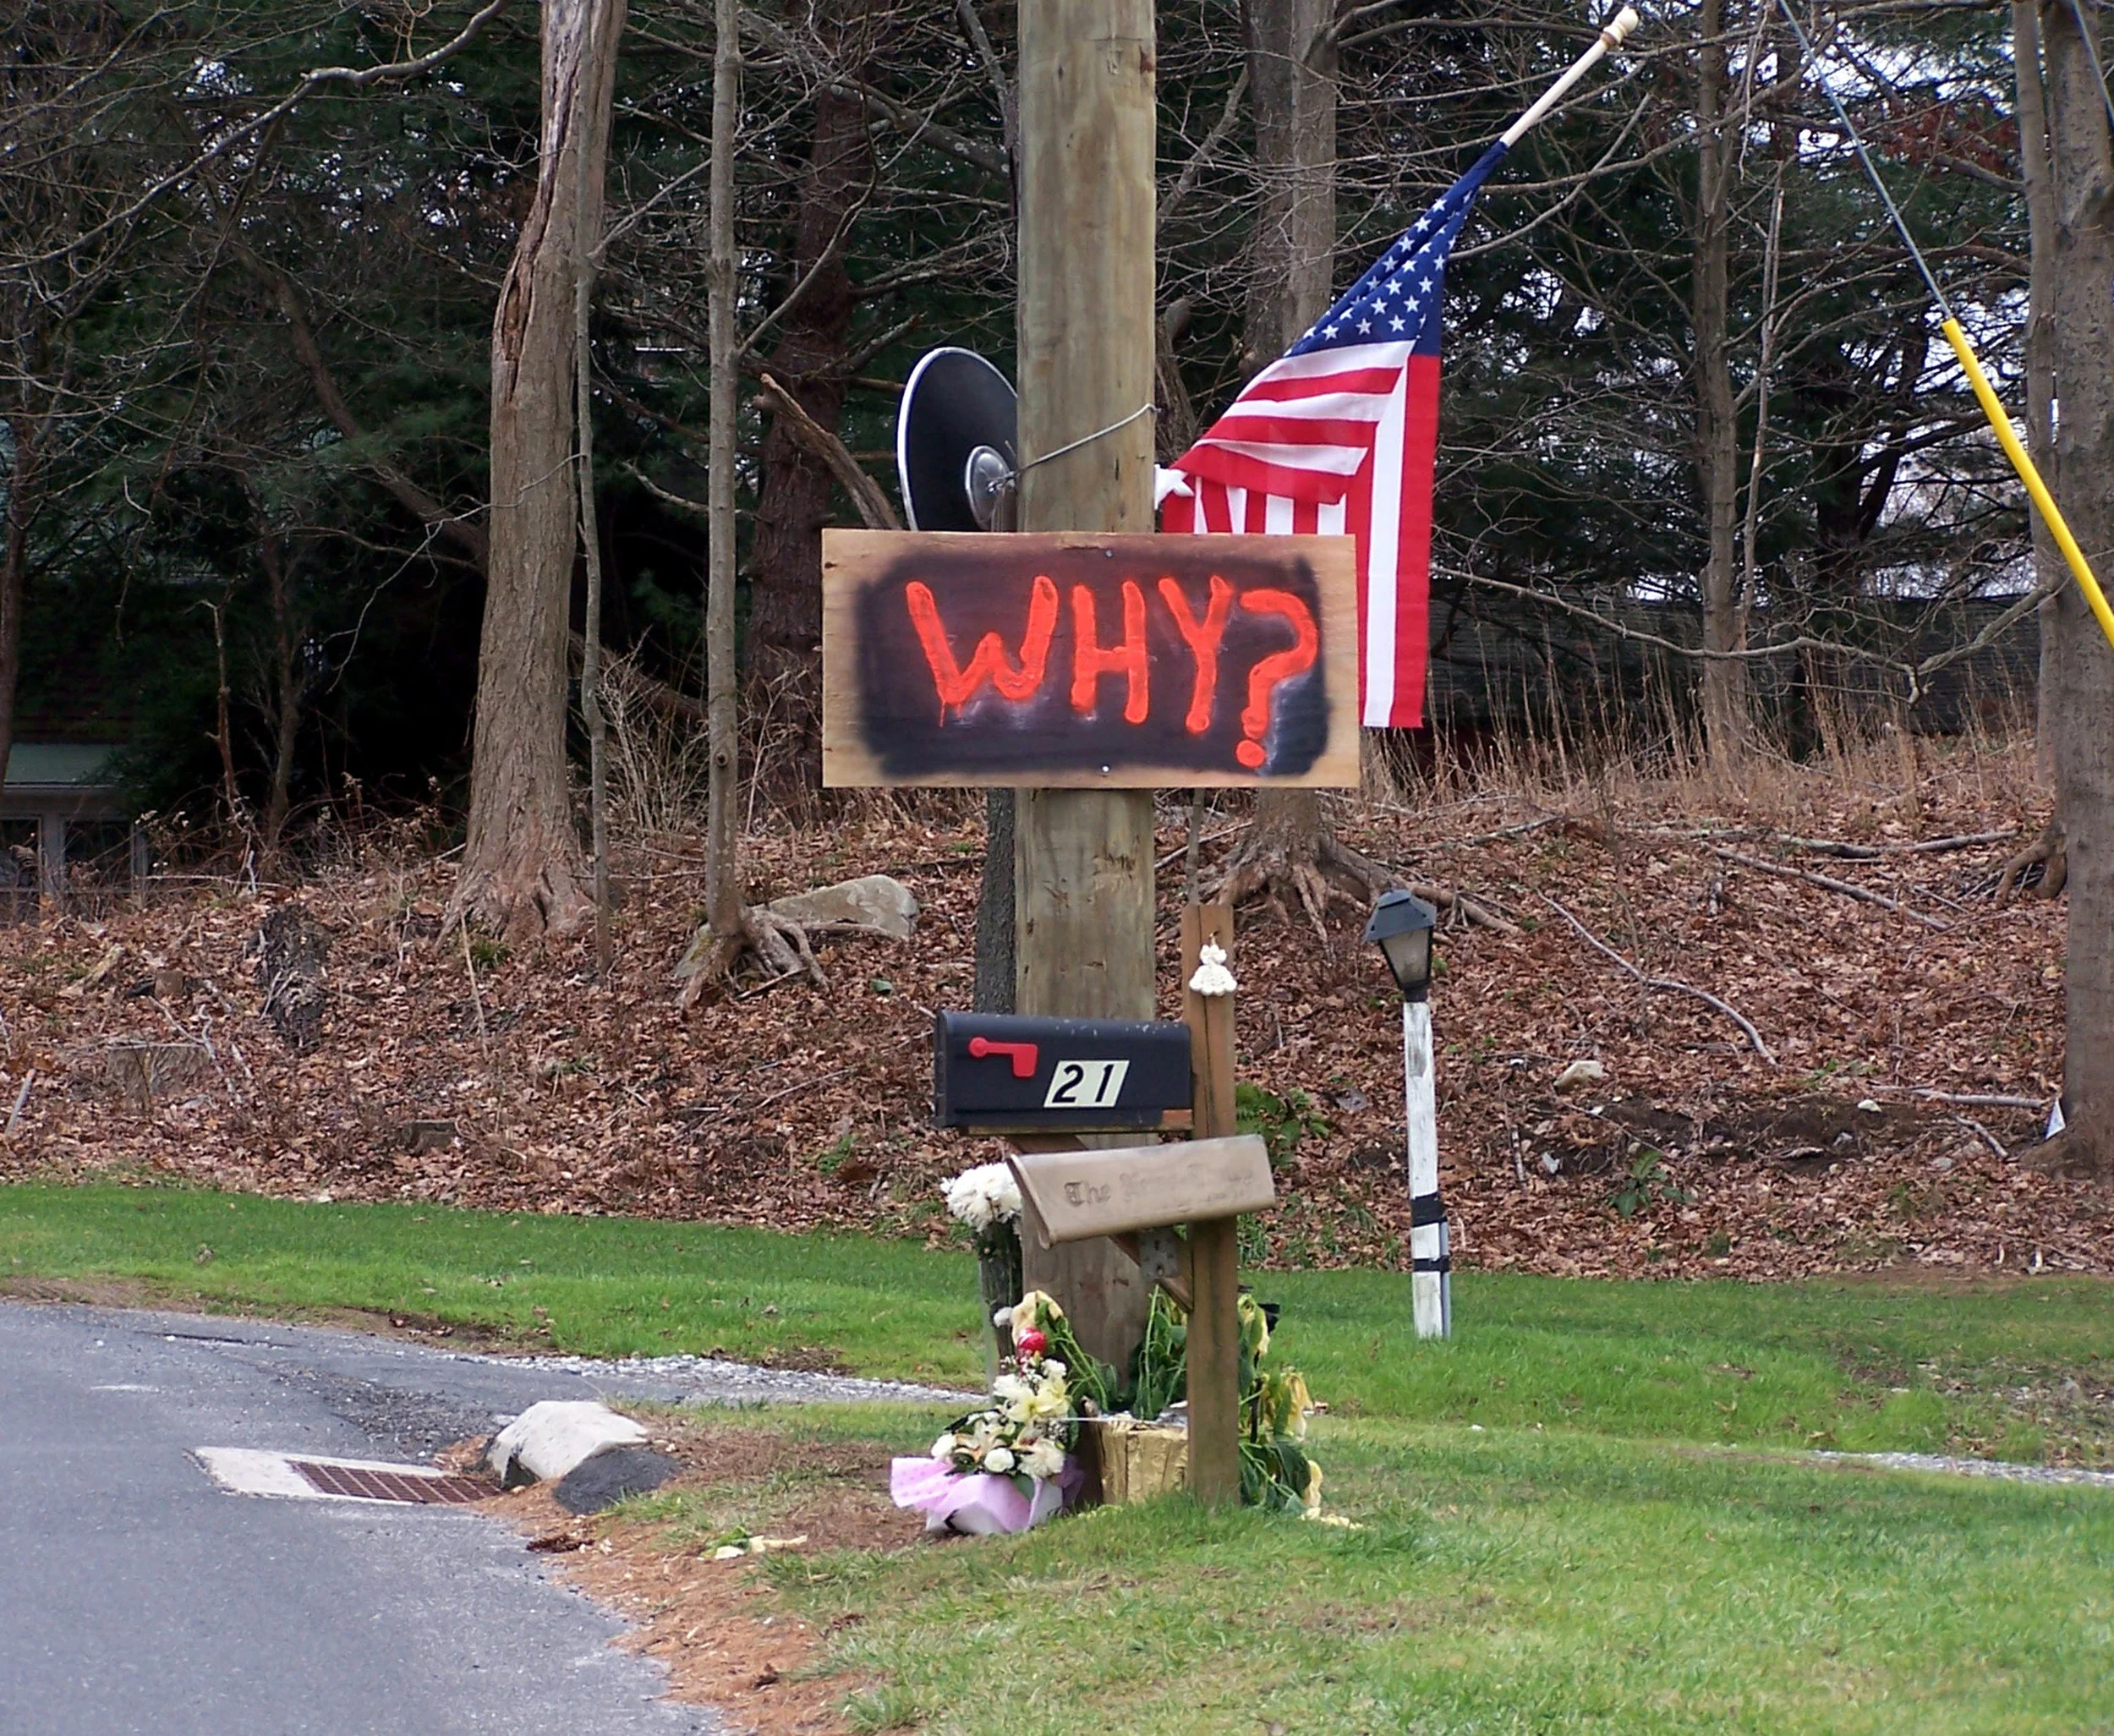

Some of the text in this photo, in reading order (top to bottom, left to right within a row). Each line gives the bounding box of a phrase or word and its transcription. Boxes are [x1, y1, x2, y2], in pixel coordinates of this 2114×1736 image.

[906, 576, 1318, 768] WHY?
[1052, 1064, 1115, 1103] 21
[1064, 1181, 1111, 1207] The
